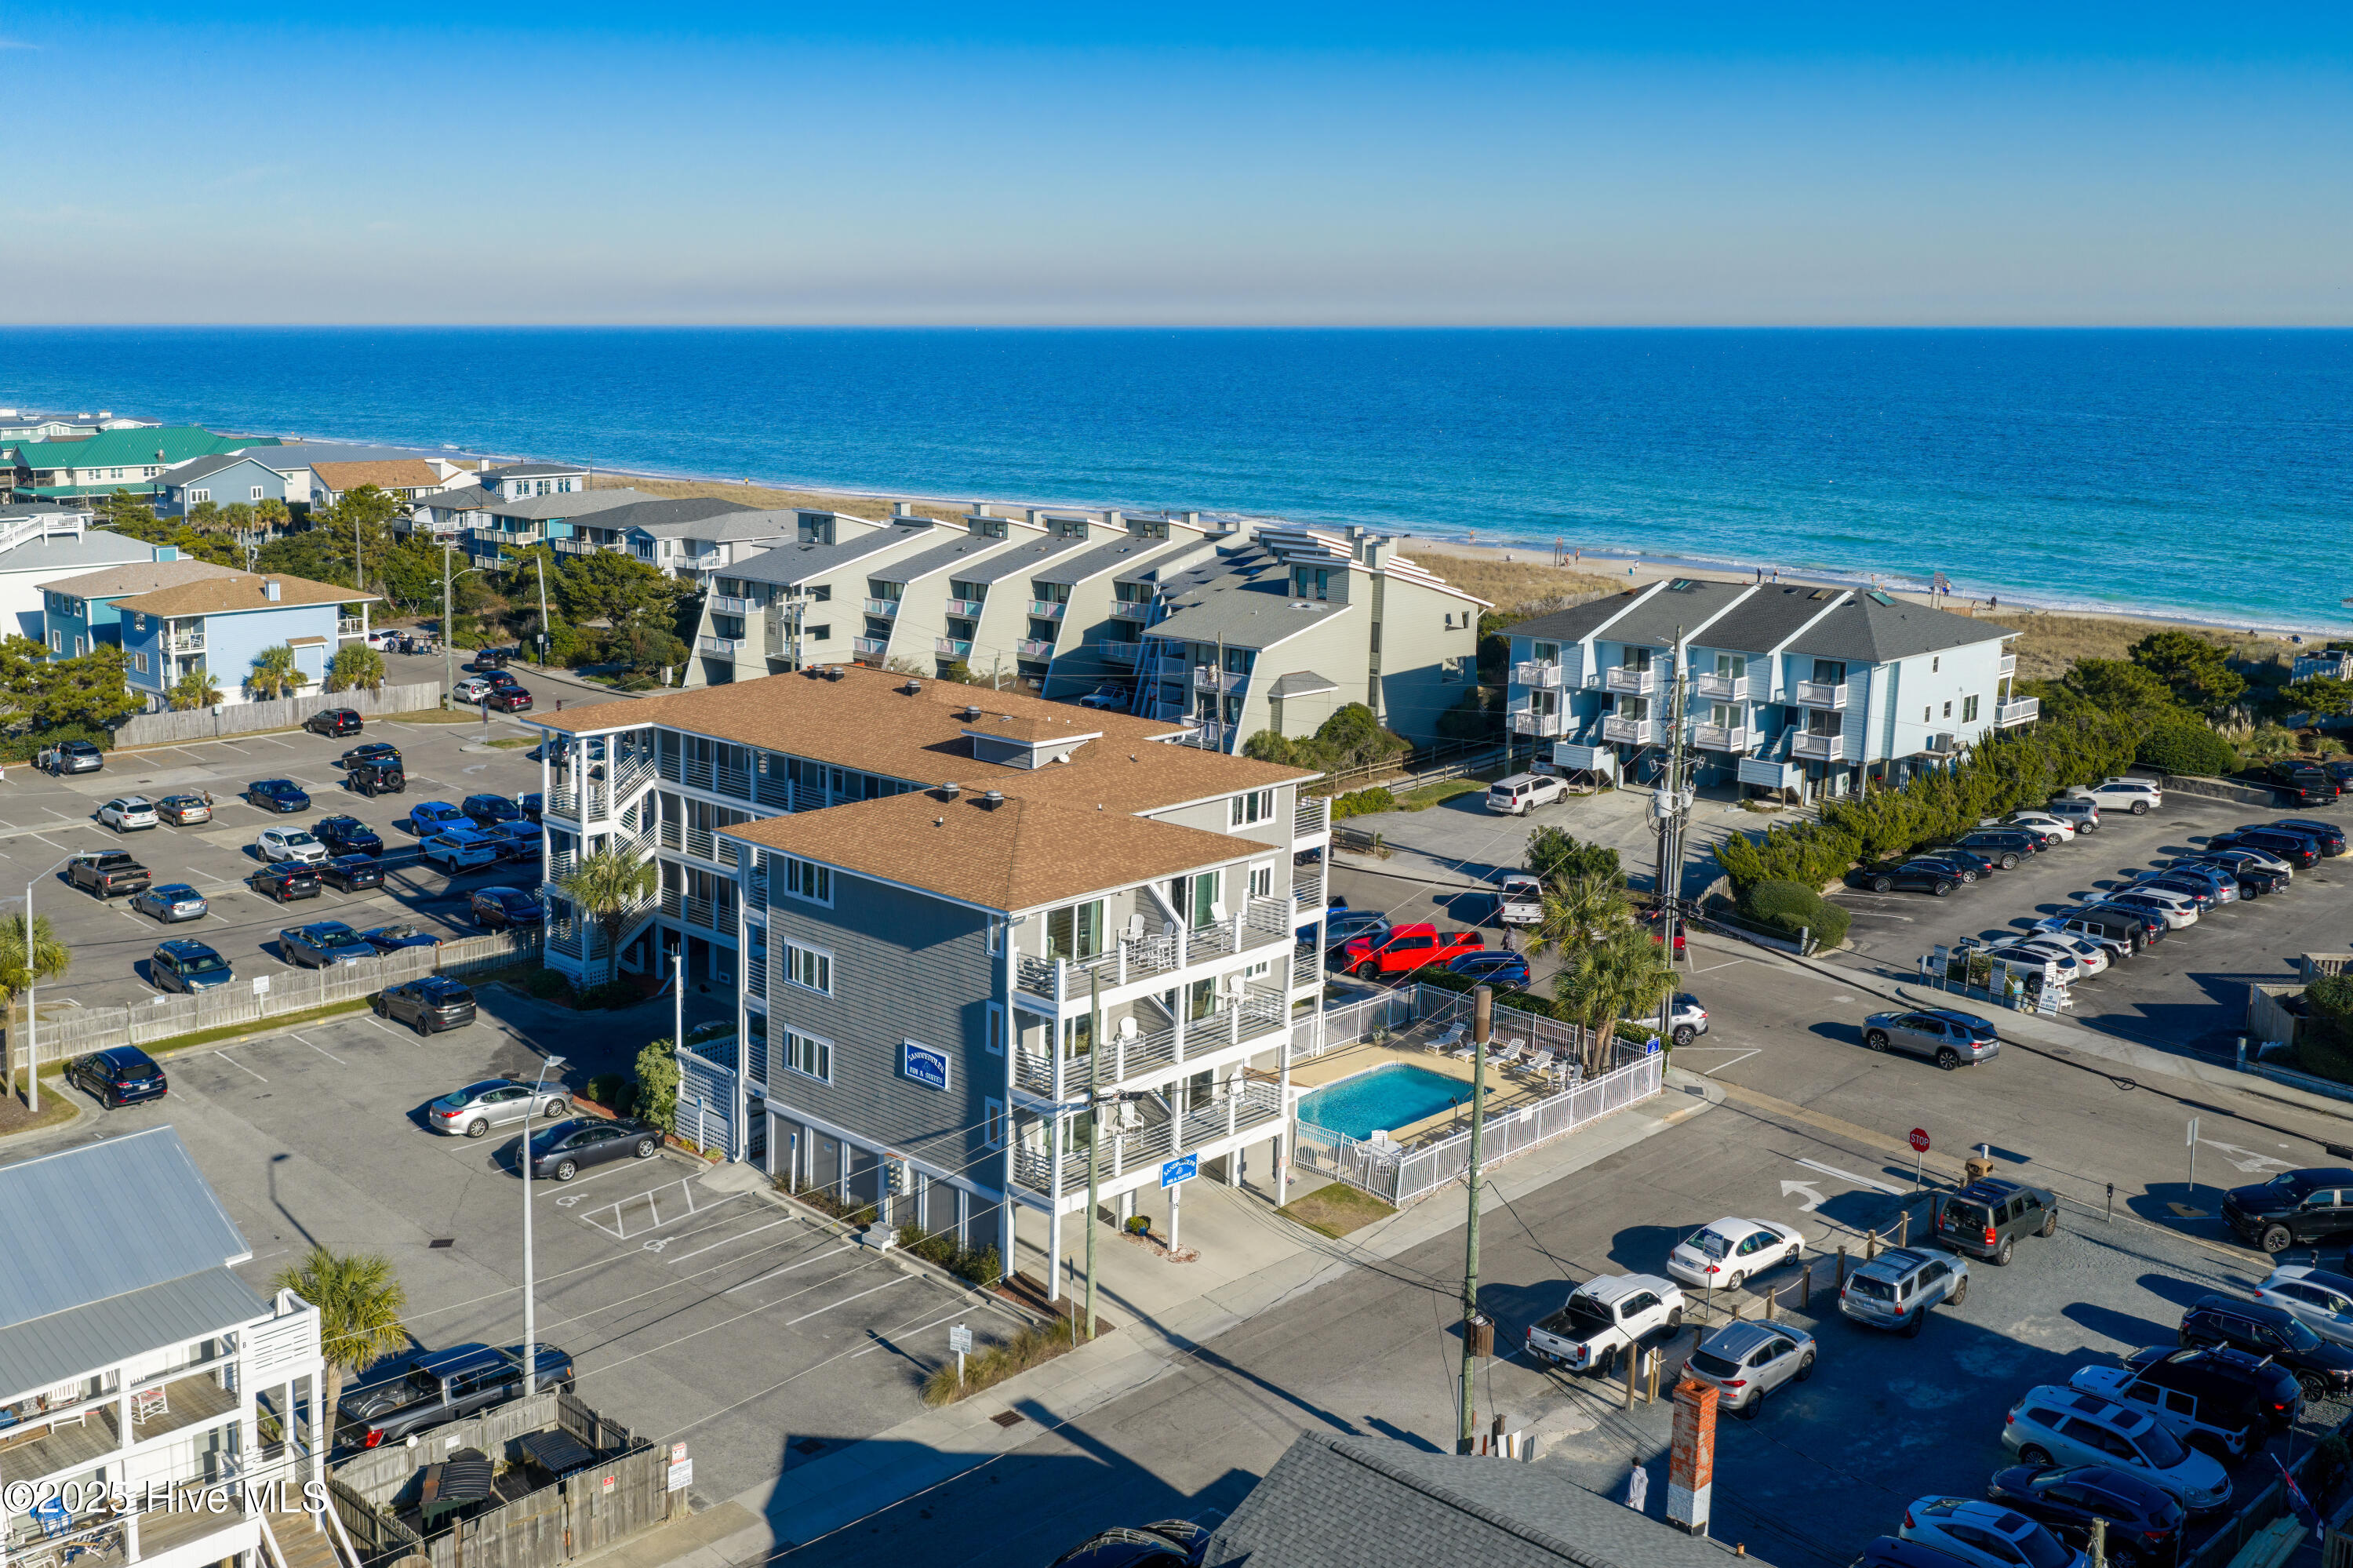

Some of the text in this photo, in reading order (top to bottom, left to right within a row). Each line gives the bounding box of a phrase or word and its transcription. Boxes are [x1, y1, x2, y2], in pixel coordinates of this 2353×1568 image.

[908, 1052, 944, 1073] SANDPEDDLER
[925, 1072, 943, 1084] SUITES
[1911, 1134, 1929, 1146] STOP
